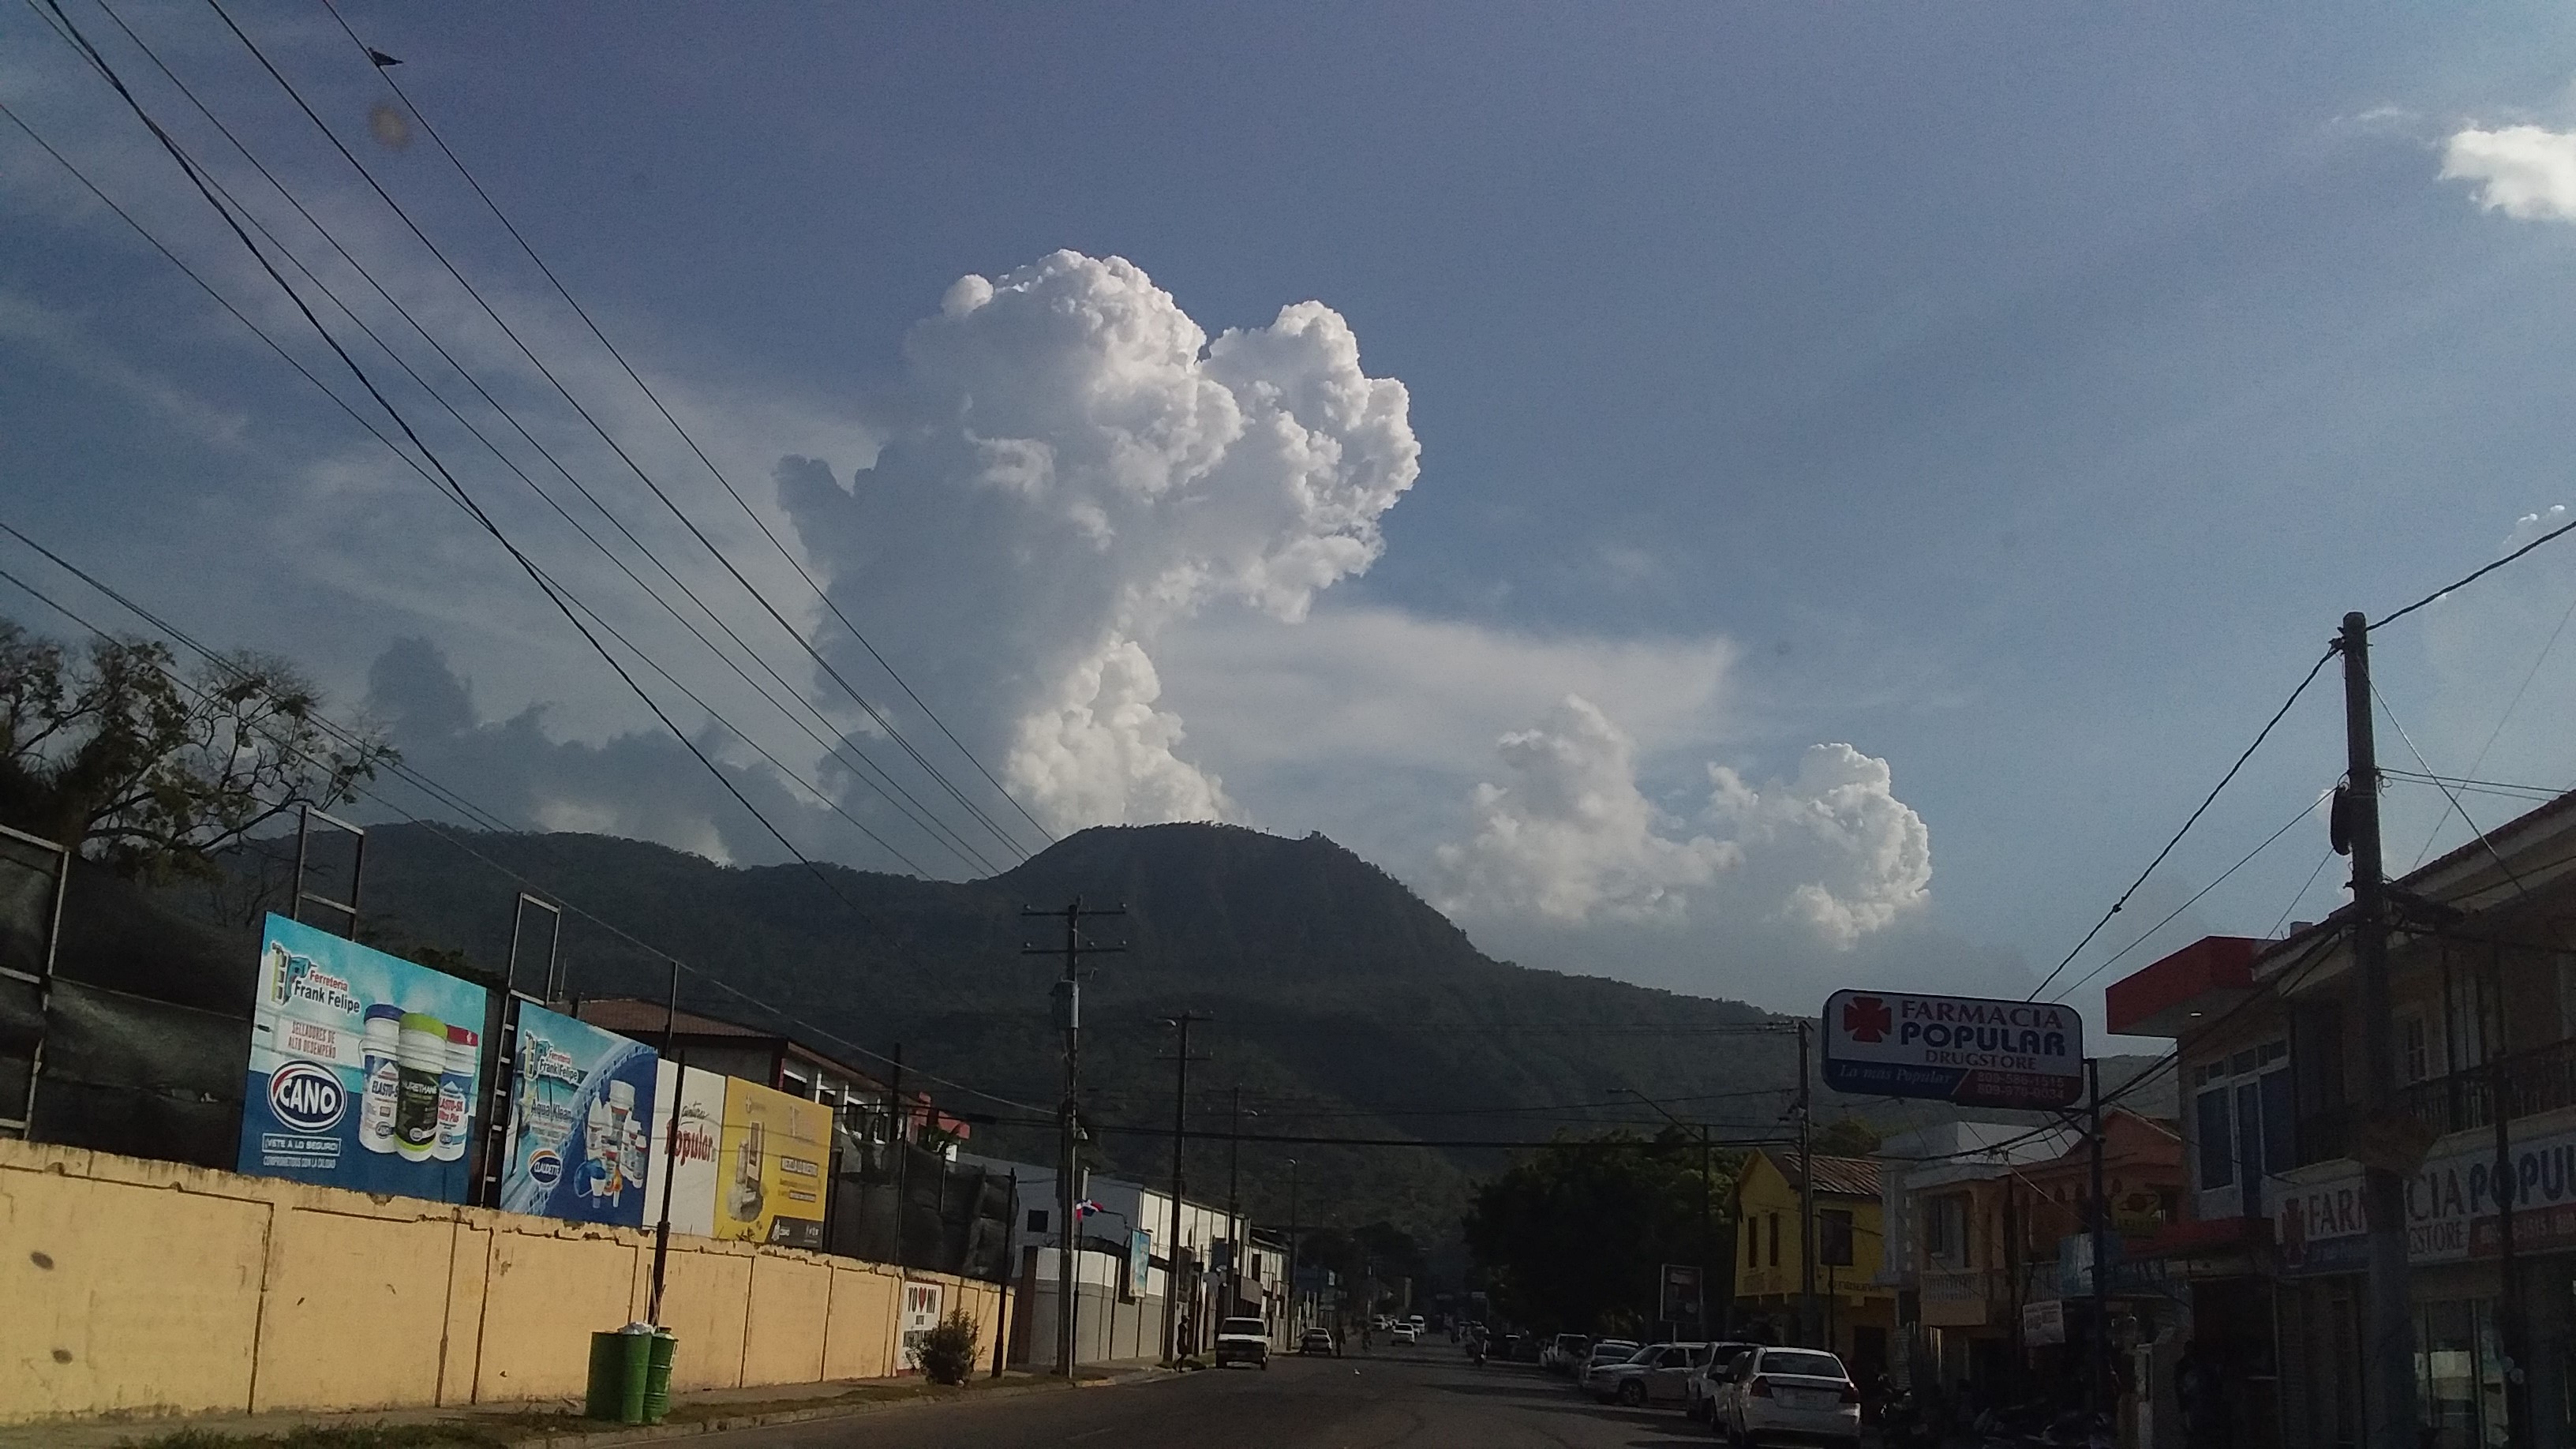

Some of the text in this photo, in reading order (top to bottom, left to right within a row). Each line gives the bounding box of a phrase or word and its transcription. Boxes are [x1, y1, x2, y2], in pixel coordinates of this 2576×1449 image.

[294, 979, 360, 1014] Frank Felipe
[1901, 999, 2063, 1029] FARMACIA
[287, 1036, 302, 1051] ALTO
[292, 1020, 335, 1044] SELLADORES DE
[1900, 1021, 2065, 1056] POPULAR
[539, 1058, 578, 1081] Frank Felipe
[1925, 1050, 2037, 1070] DRUGSTORE
[1840, 1065, 1858, 1078] La
[1896, 1069, 1952, 1084] Popular
[279, 1078, 336, 1114] CANO
[531, 1099, 571, 1120] Aqua Klean
[287, 1140, 293, 1148] A
[294, 1140, 305, 1149] LO
[534, 1162, 560, 1176] CLAUDETTE
[908, 1287, 936, 1313] YO MI
